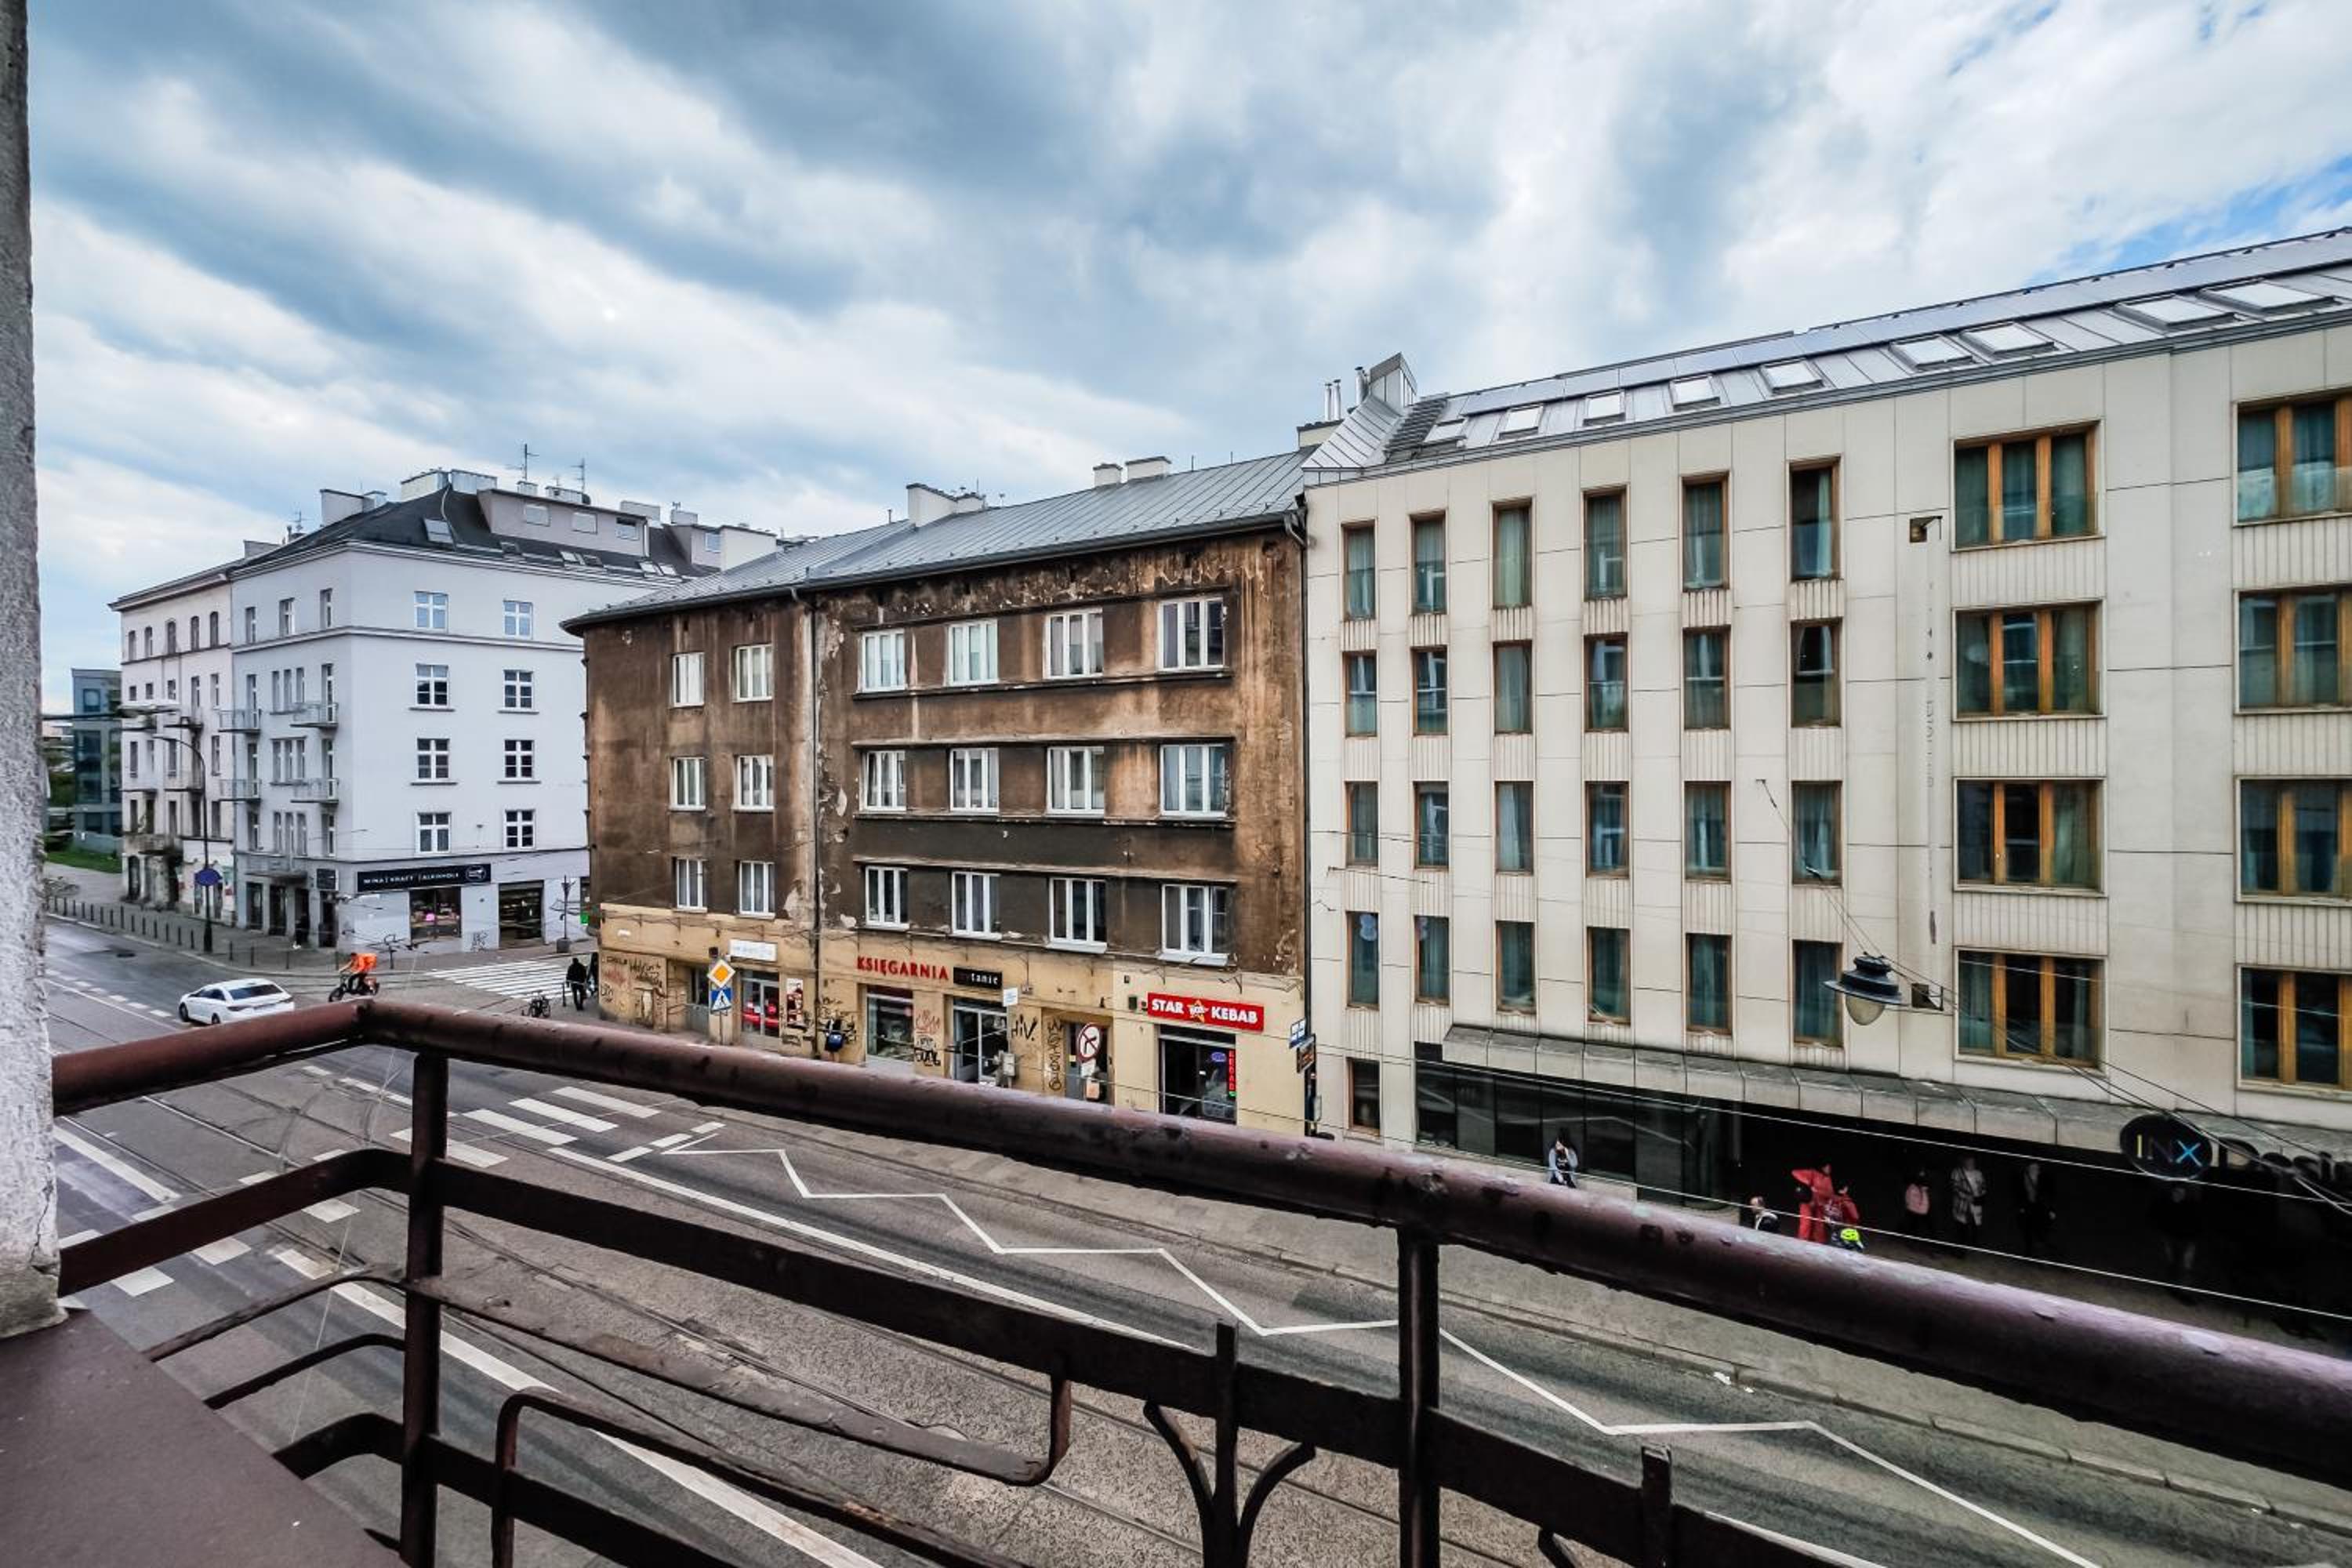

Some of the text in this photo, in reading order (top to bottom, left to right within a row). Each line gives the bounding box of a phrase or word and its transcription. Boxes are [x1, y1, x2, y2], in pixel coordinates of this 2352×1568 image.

[857, 956, 949, 980] KSIĘGARNIA
[1151, 998, 1185, 1014] STAR
[1210, 1006, 1258, 1024] KEBAB
